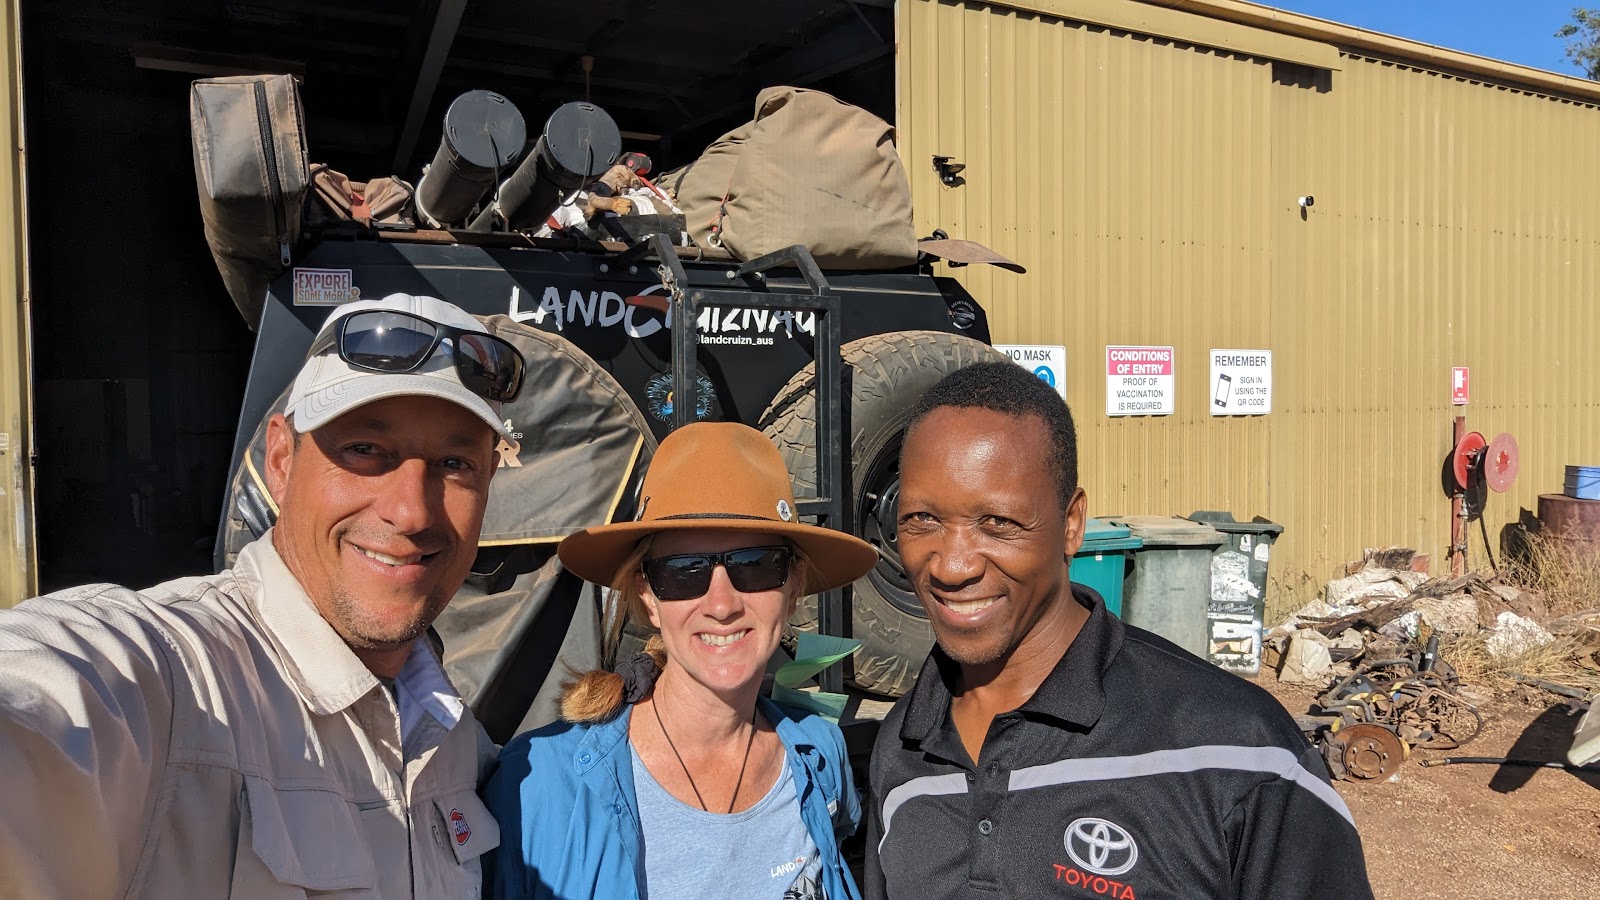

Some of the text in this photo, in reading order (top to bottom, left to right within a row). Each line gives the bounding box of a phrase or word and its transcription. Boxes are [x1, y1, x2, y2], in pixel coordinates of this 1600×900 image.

[298, 273, 347, 291] EXPLORE
[298, 290, 321, 301] SOME
[1005, 349, 1051, 361] NO MASK
[1110, 350, 1170, 361] CONDITIONS
[1215, 355, 1267, 367] REMEMBER
[1116, 363, 1163, 374] OF ENTRY
[1122, 377, 1158, 386] PROOF OF
[1239, 376, 1262, 384] SIGN IN
[1116, 389, 1164, 398] VACCINATION
[1234, 387, 1267, 395] USING THE
[1118, 401, 1162, 411] IS REQUIRED
[1237, 398, 1265, 406] QR CODE
[1052, 863, 1136, 900] TOYOTA
